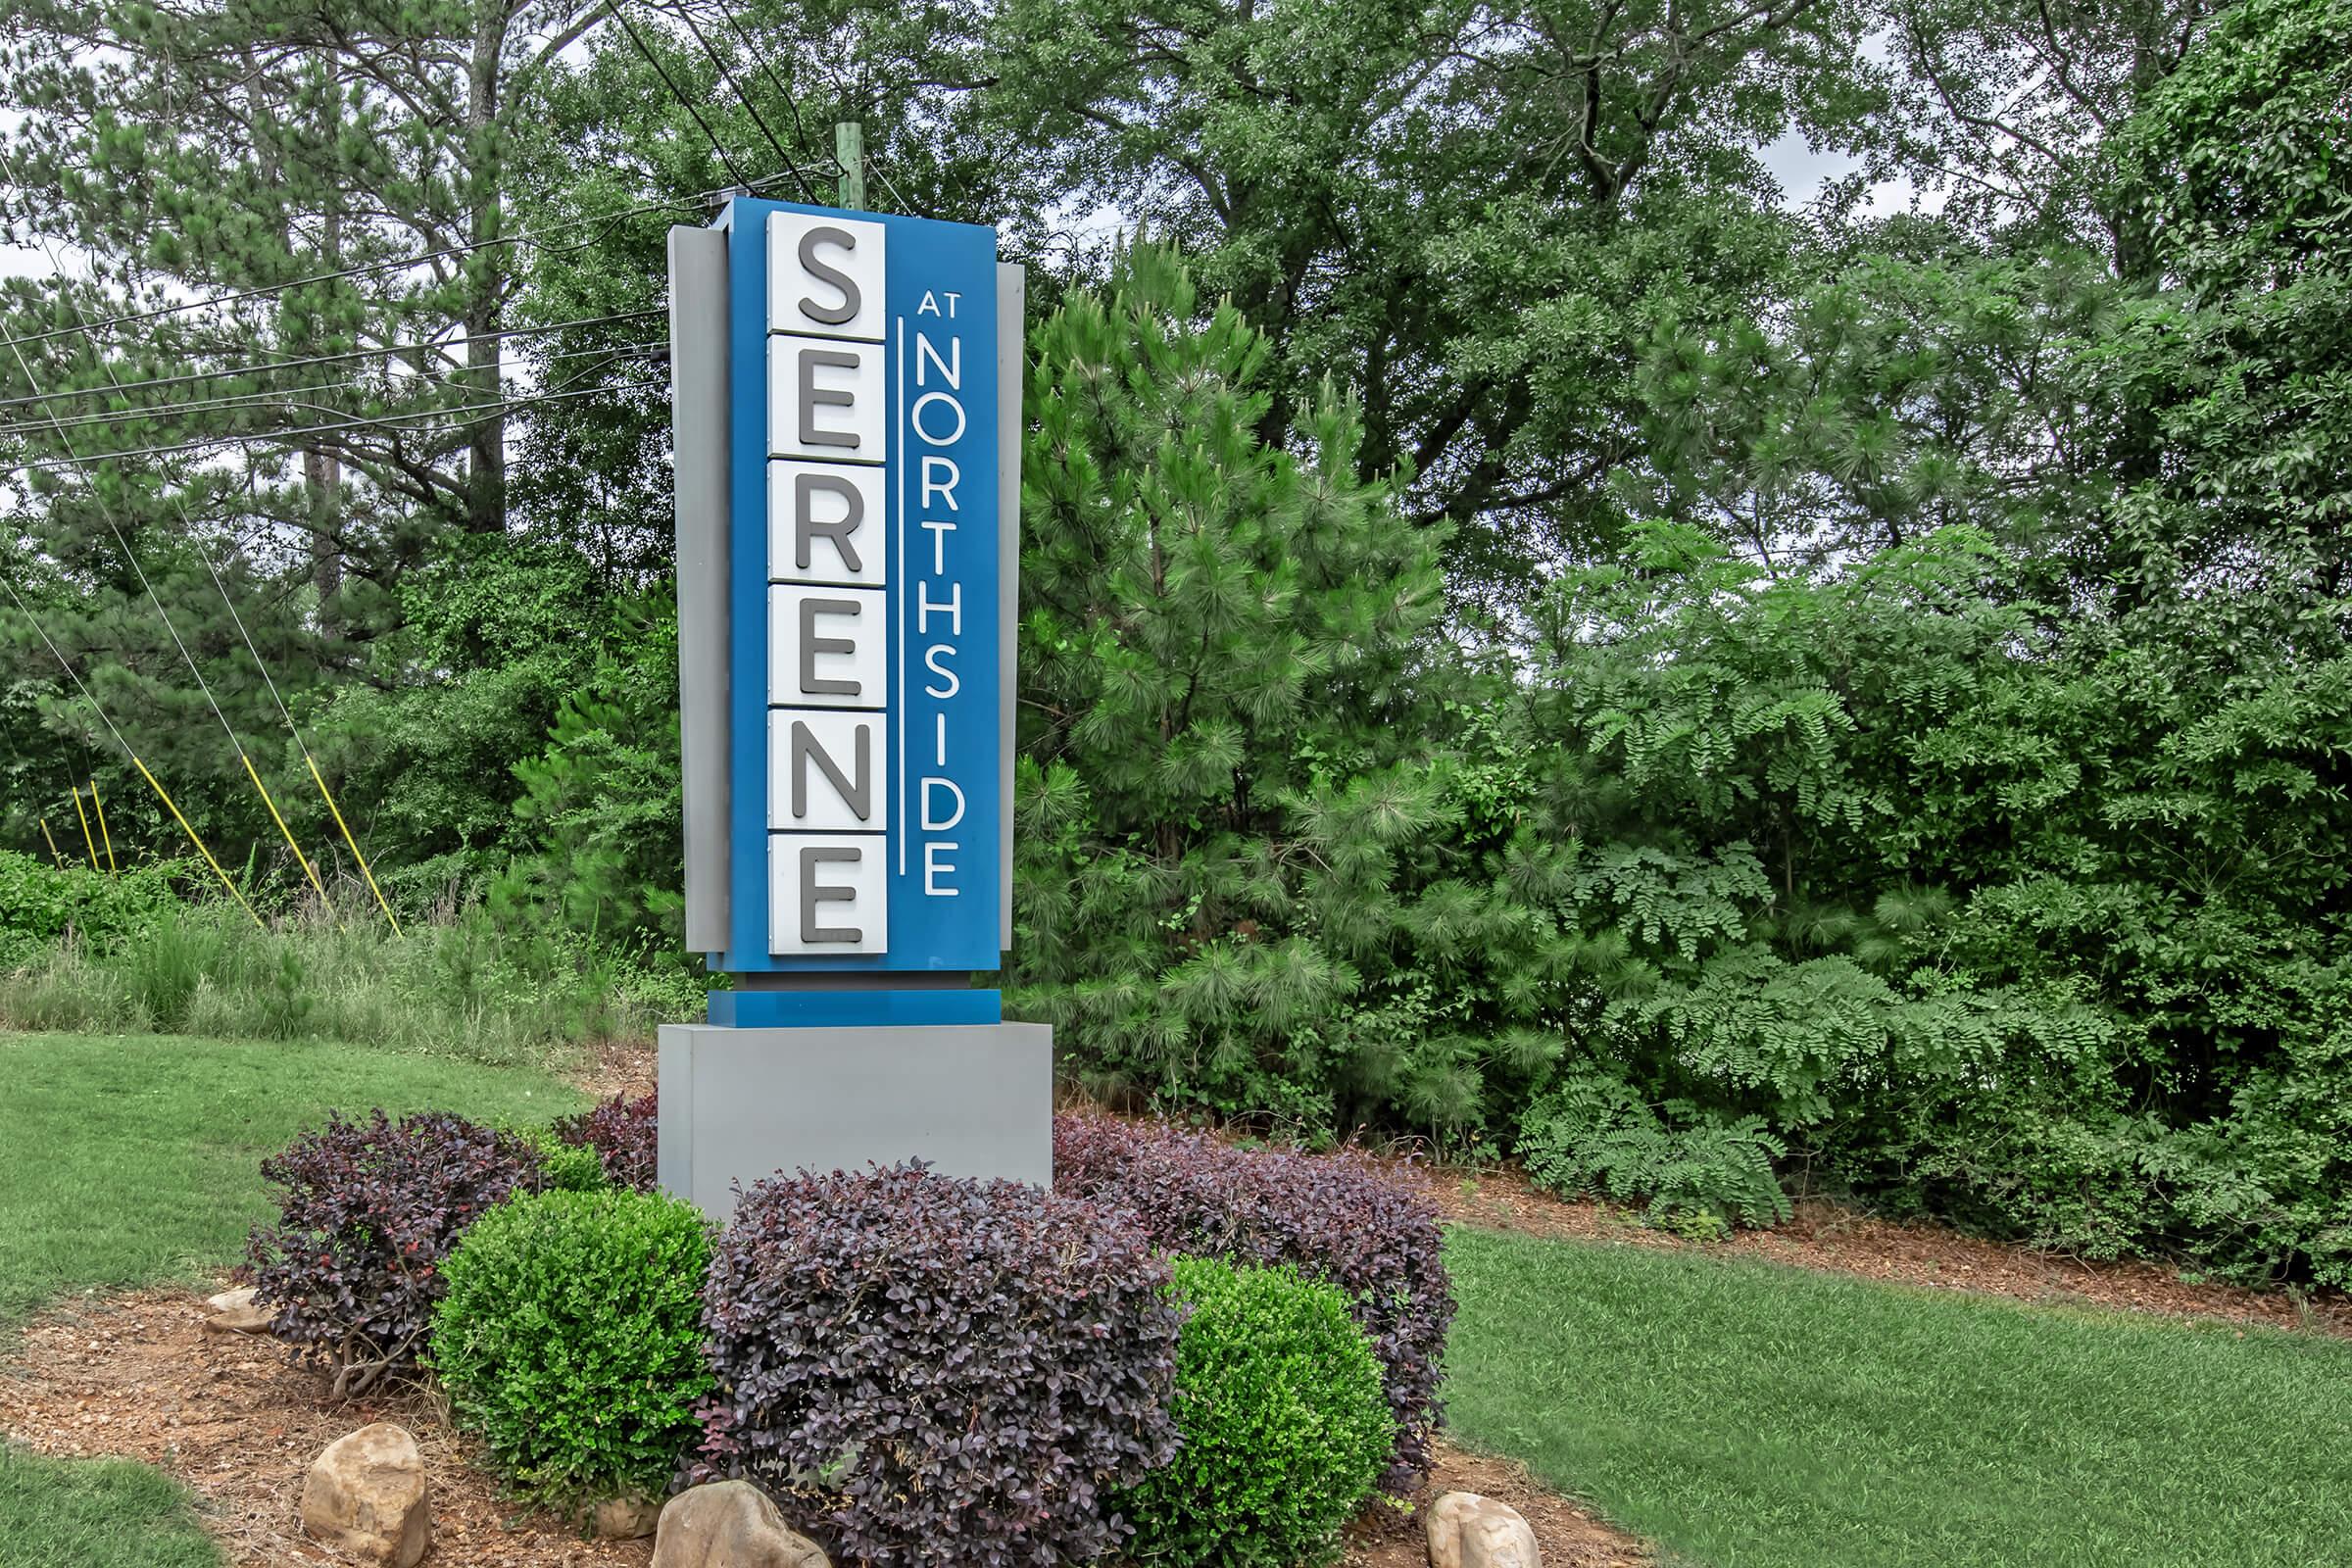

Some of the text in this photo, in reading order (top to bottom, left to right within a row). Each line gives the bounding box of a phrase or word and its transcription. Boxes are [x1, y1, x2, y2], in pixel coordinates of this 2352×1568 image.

[791, 226, 871, 946] SERENE
[916, 290, 961, 318] AT
[911, 332, 966, 897] NORTHSIDE
